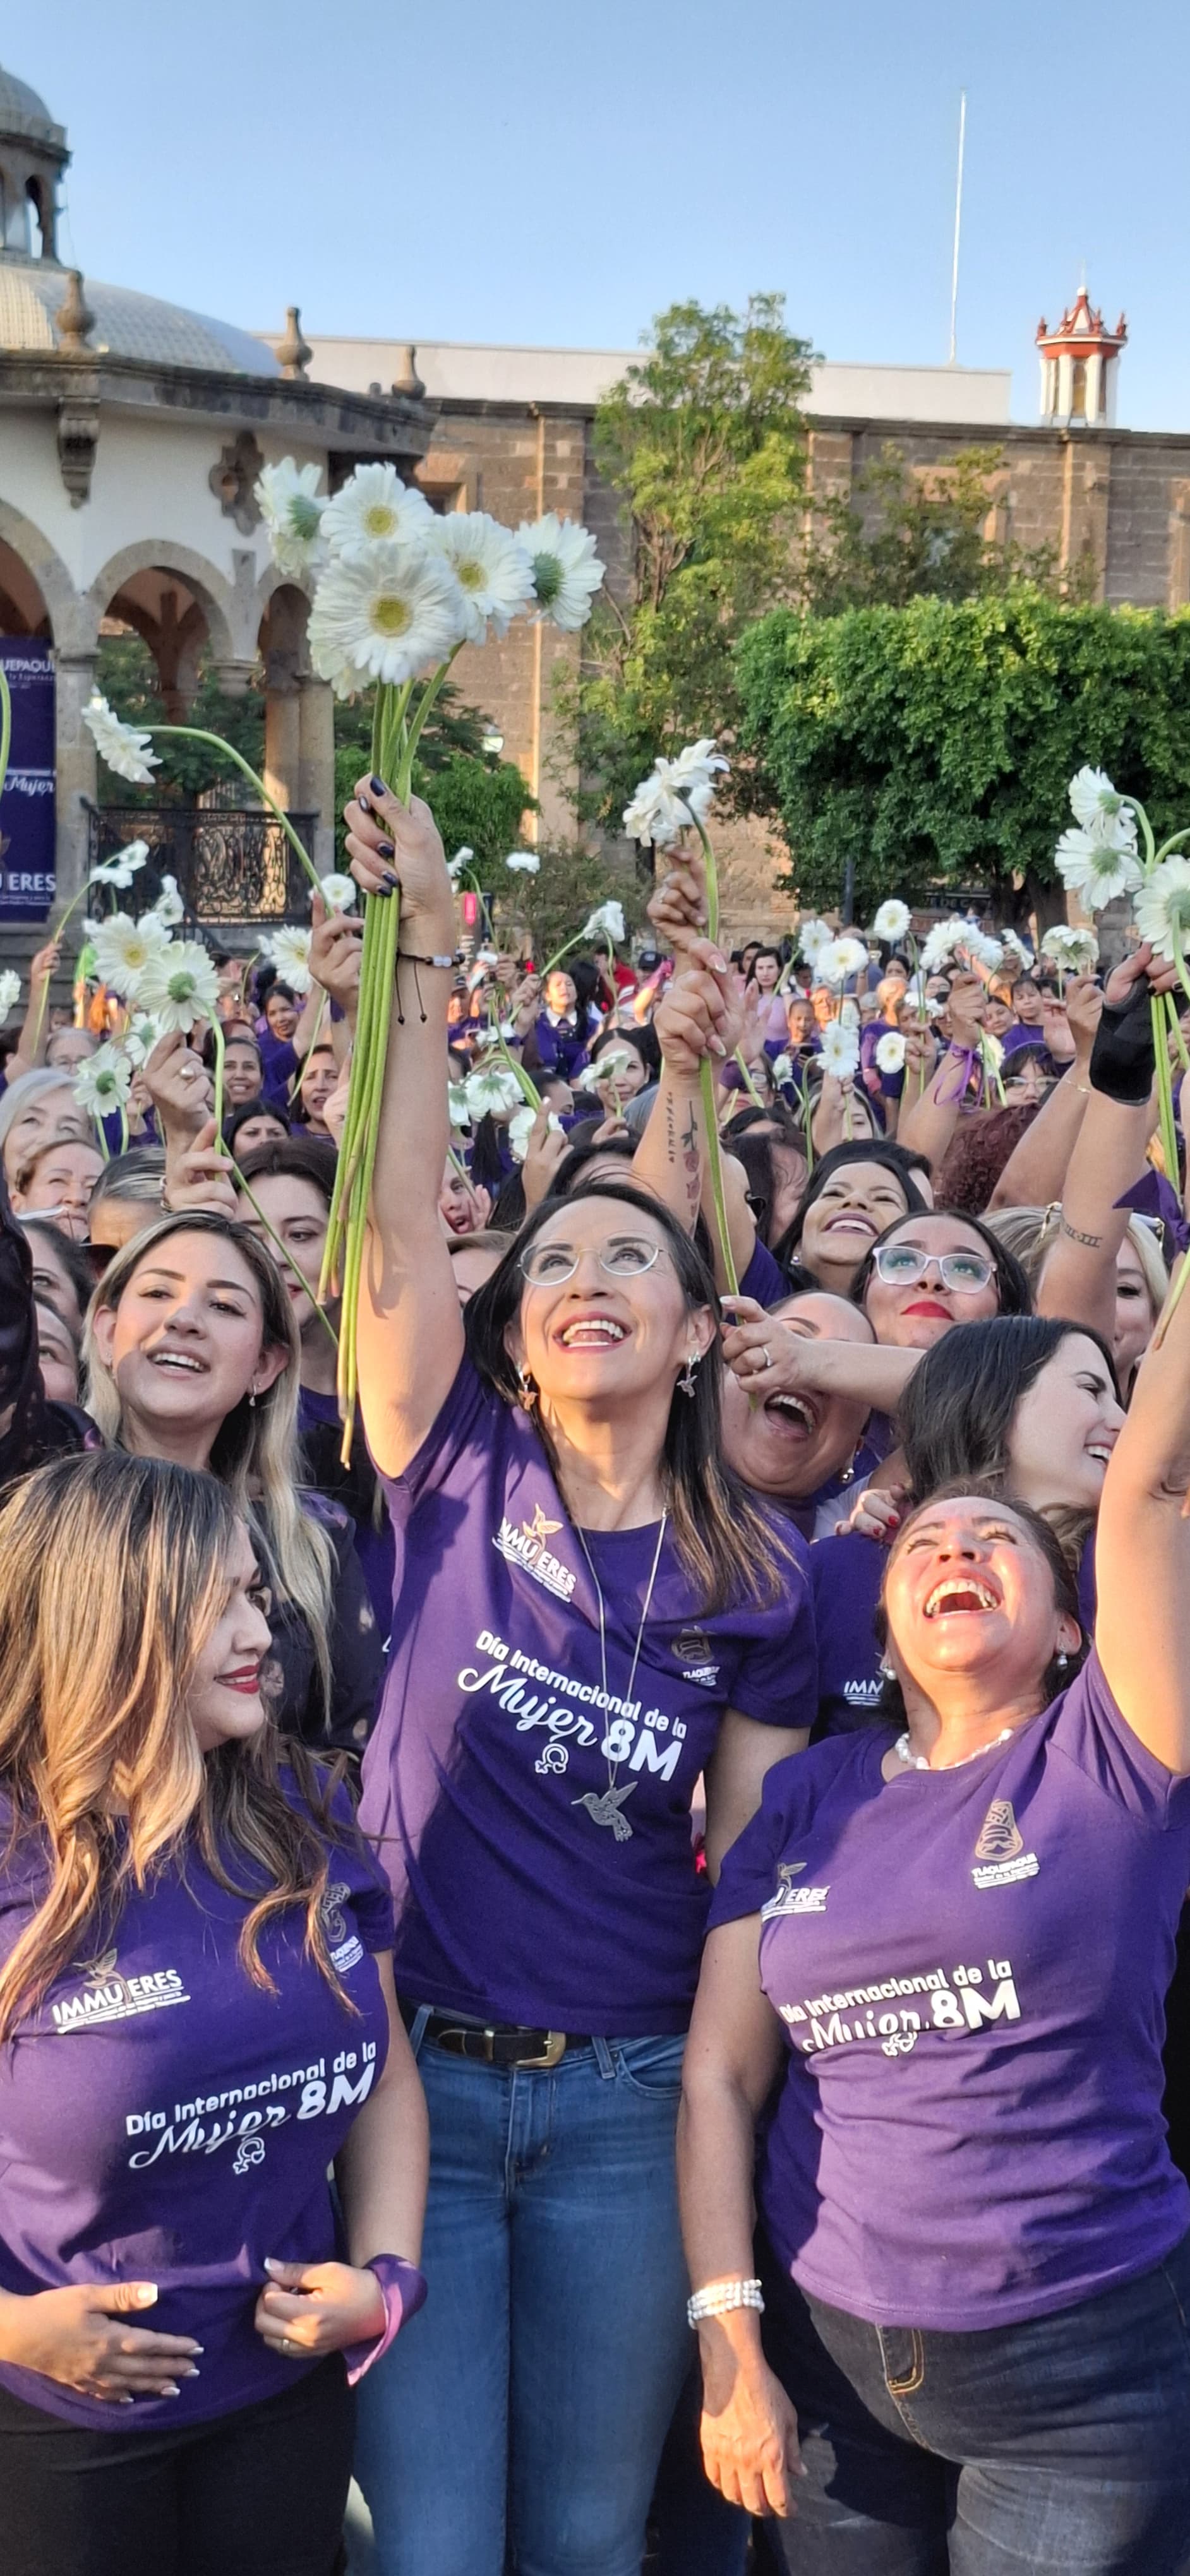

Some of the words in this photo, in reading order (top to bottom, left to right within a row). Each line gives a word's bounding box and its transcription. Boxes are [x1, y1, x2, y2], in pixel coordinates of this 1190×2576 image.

[4, 776, 54, 797] Mujer
[457, 1664, 598, 1746] Mujer
[601, 1719, 683, 1782] 8M
[476, 1630, 510, 1661] Día
[510, 1649, 642, 1721] Internacional
[644, 1708, 670, 1731] de
[672, 1717, 687, 1739] la
[803, 1968, 950, 2017] Internacional
[953, 1965, 983, 1986] de
[987, 1959, 1013, 1980] la
[931, 1979, 1021, 2030] 8M
[126, 2111, 166, 2136] Día
[174, 2058, 326, 2123] Internacional
[333, 2051, 358, 2073] de
[362, 2041, 376, 2063] la
[129, 2106, 292, 2169] Mujer
[296, 2061, 376, 2120] 8M
